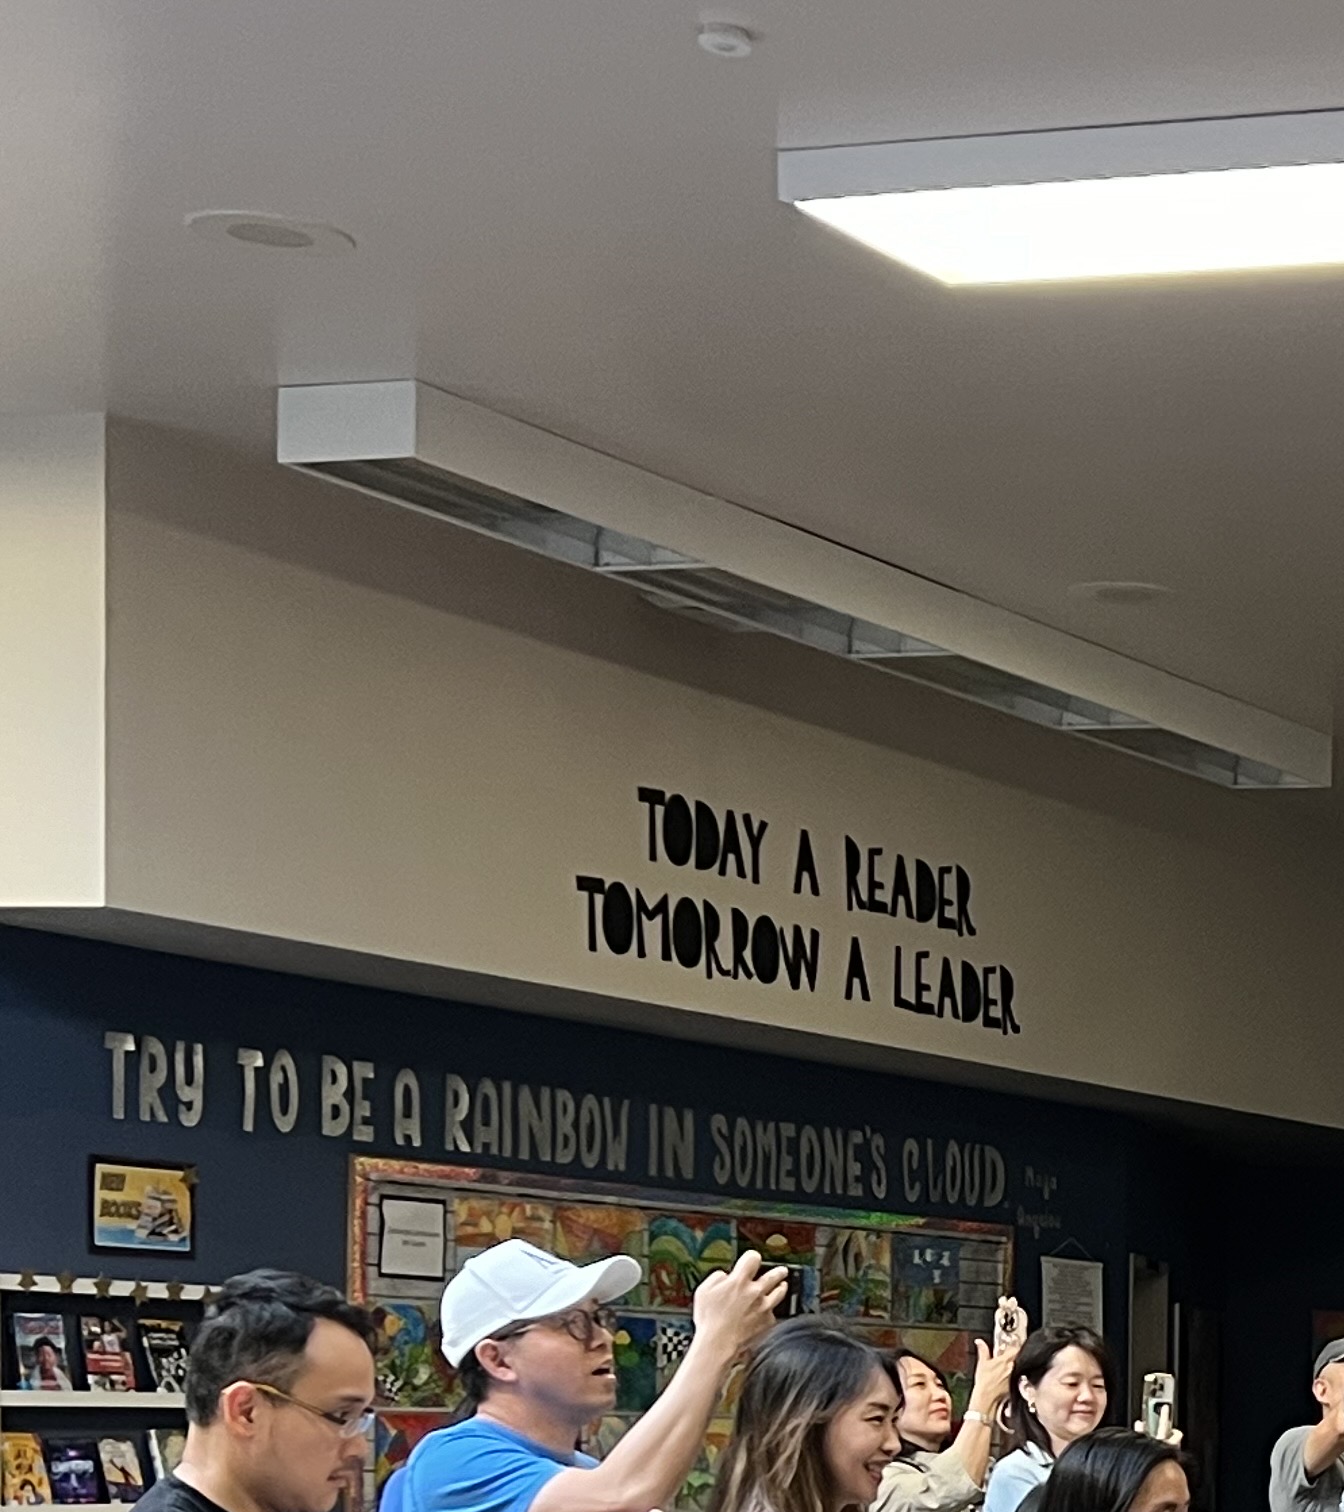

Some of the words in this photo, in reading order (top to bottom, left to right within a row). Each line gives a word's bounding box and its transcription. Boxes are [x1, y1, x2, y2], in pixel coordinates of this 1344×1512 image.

[637, 786, 768, 885] TODAY
[793, 829, 820, 896] A
[845, 835, 977, 937] READER
[576, 875, 820, 993] TOMORROW
[844, 936, 871, 1002] A
[894, 945, 1021, 1036] LEADER
[104, 1031, 204, 1127] TRY
[237, 1047, 298, 1133] TO
[321, 1054, 374, 1142] BE
[394, 1068, 422, 1147] A
[444, 1073, 630, 1171] RAINBOW
[648, 1103, 695, 1180] IN
[711, 1113, 886, 1200] SOMEONE'S
